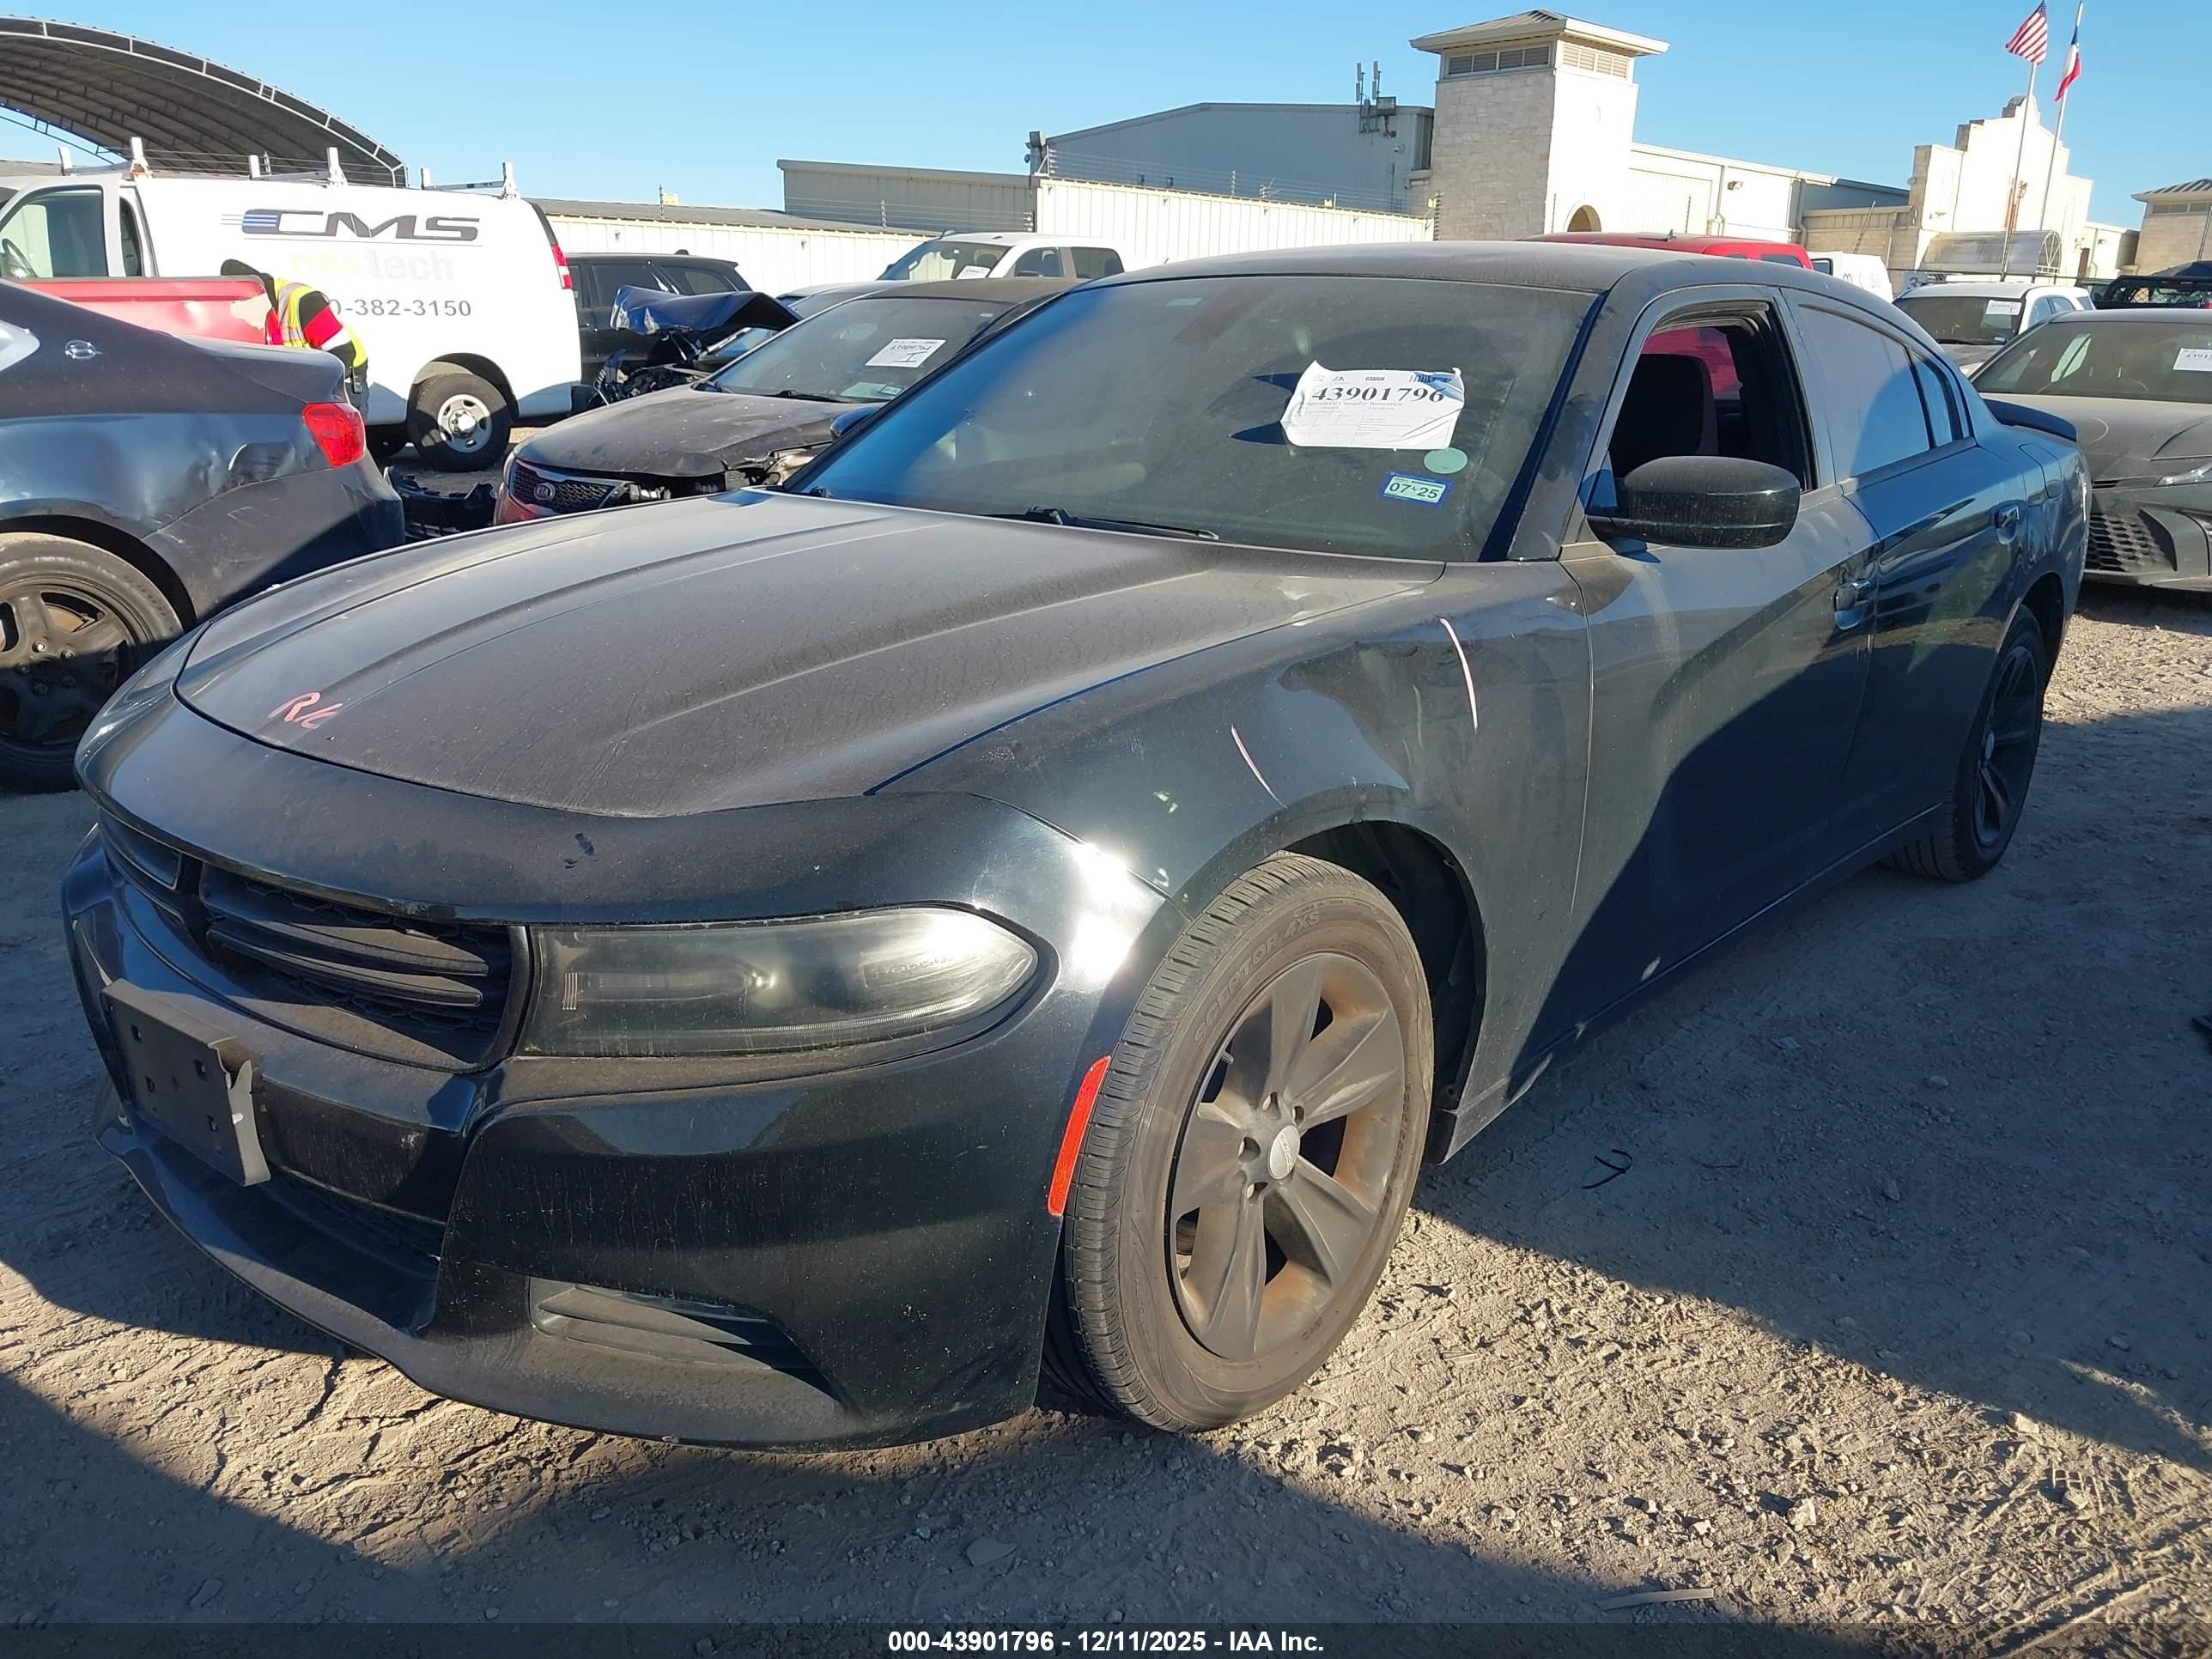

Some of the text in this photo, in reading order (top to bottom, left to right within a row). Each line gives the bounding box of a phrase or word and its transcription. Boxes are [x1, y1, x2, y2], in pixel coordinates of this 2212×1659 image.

[241, 209, 480, 241] CMS
[1312, 386, 1445, 402] 43901796
[1389, 483, 1439, 498] 07 25
